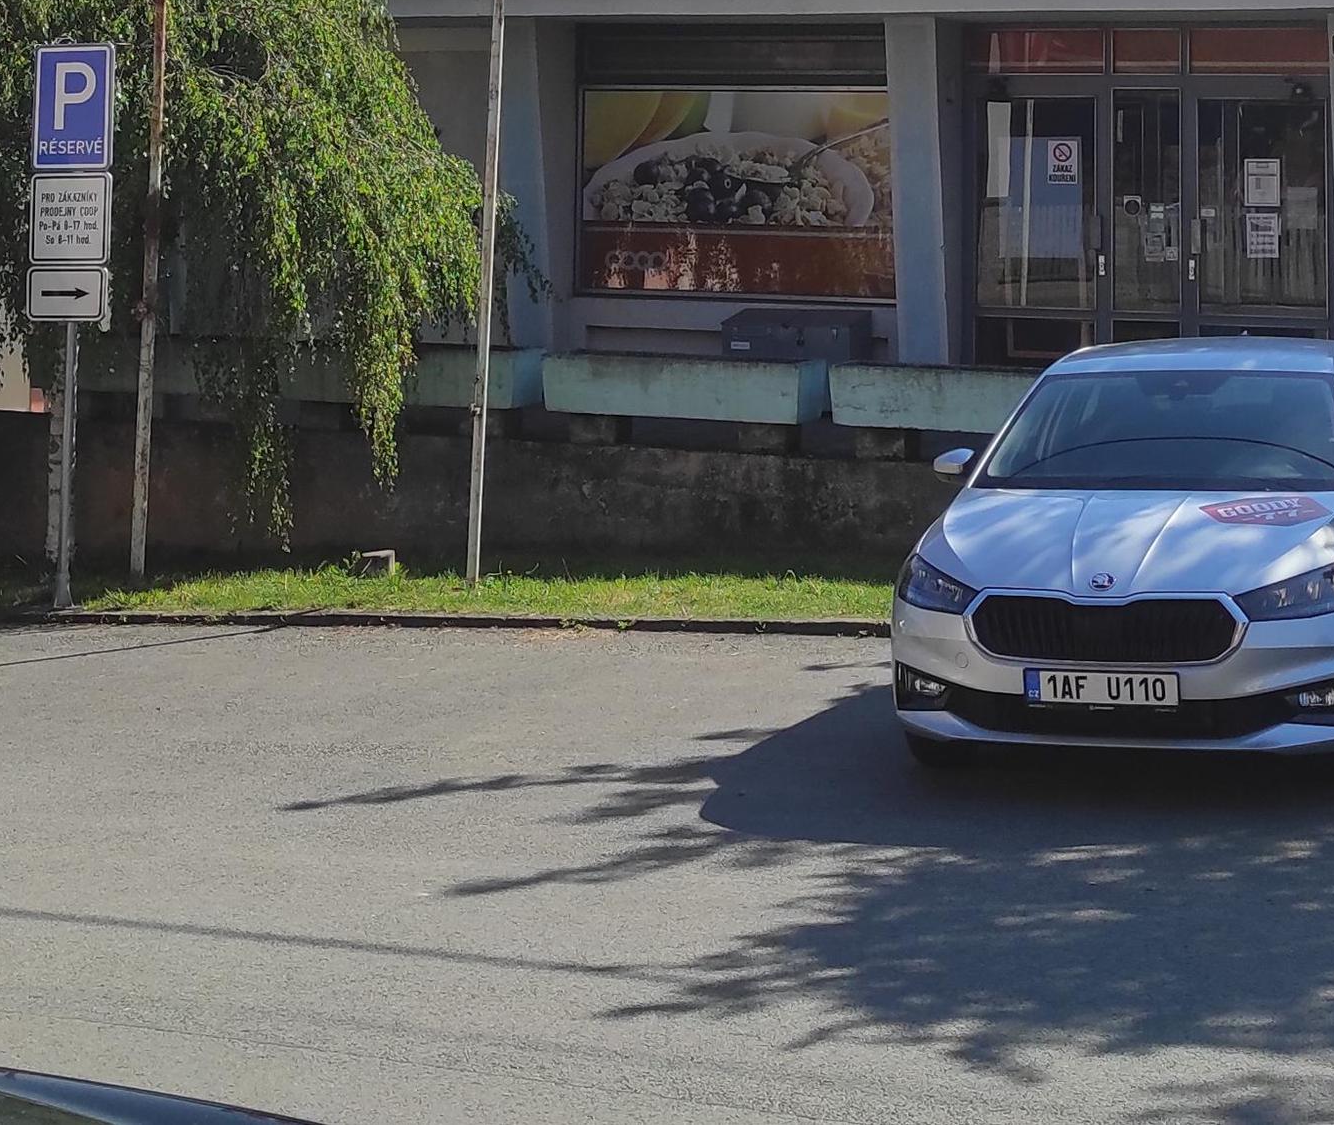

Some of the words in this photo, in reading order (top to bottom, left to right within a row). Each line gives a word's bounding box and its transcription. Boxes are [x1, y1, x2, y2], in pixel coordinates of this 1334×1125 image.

[53, 61, 97, 131] P
[38, 137, 103, 156] RÉSERVÉ
[1052, 163, 1073, 173] ZÁKAZ
[41, 192, 55, 203] PRO
[58, 189, 98, 203] ZÁKAZNÍKY
[40, 206, 76, 217] PRODEJNY
[79, 206, 98, 217] COOP
[38, 220, 61, 231] Po-Pá
[83, 220, 99, 230] hod.
[45, 234, 55, 245] So
[76, 234, 91, 245] hod.
[1216, 497, 1303, 518] GOODY
[1028, 690, 1039, 698] CZ
[1047, 674, 1088, 700] 1AF
[1107, 677, 1166, 702] U110
